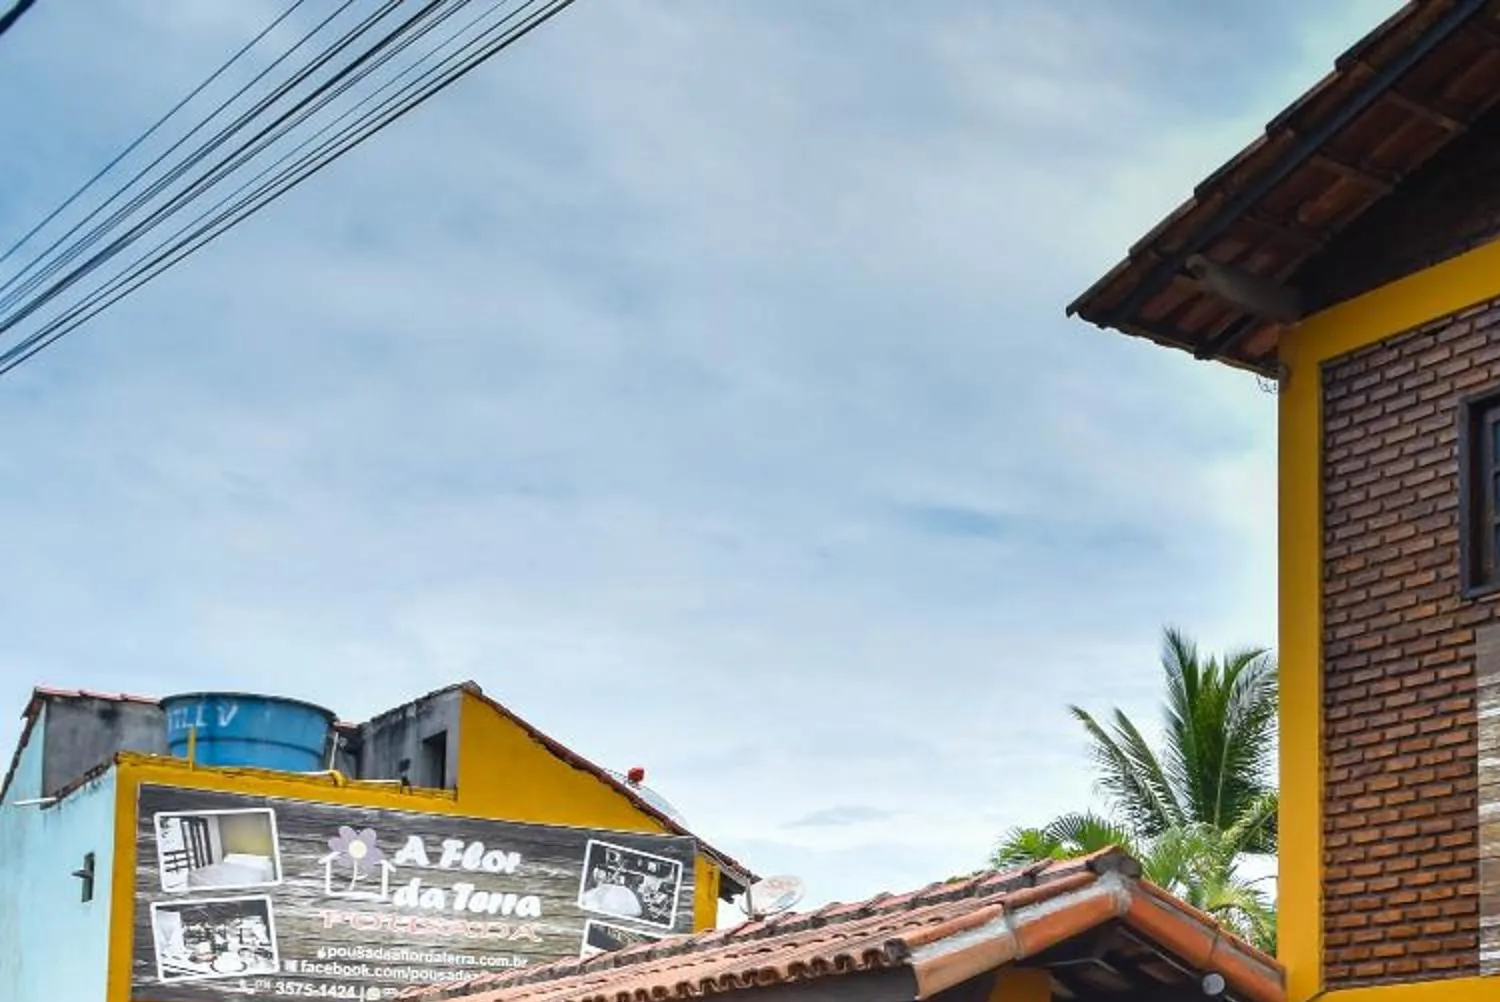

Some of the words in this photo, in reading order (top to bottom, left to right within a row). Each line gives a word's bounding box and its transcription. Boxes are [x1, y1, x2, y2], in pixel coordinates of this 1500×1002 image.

[394, 835, 430, 866] A
[439, 838, 522, 874] Flor
[392, 877, 446, 910] da
[452, 882, 542, 917] Terra
[275, 980, 357, 998] 3575-1424
